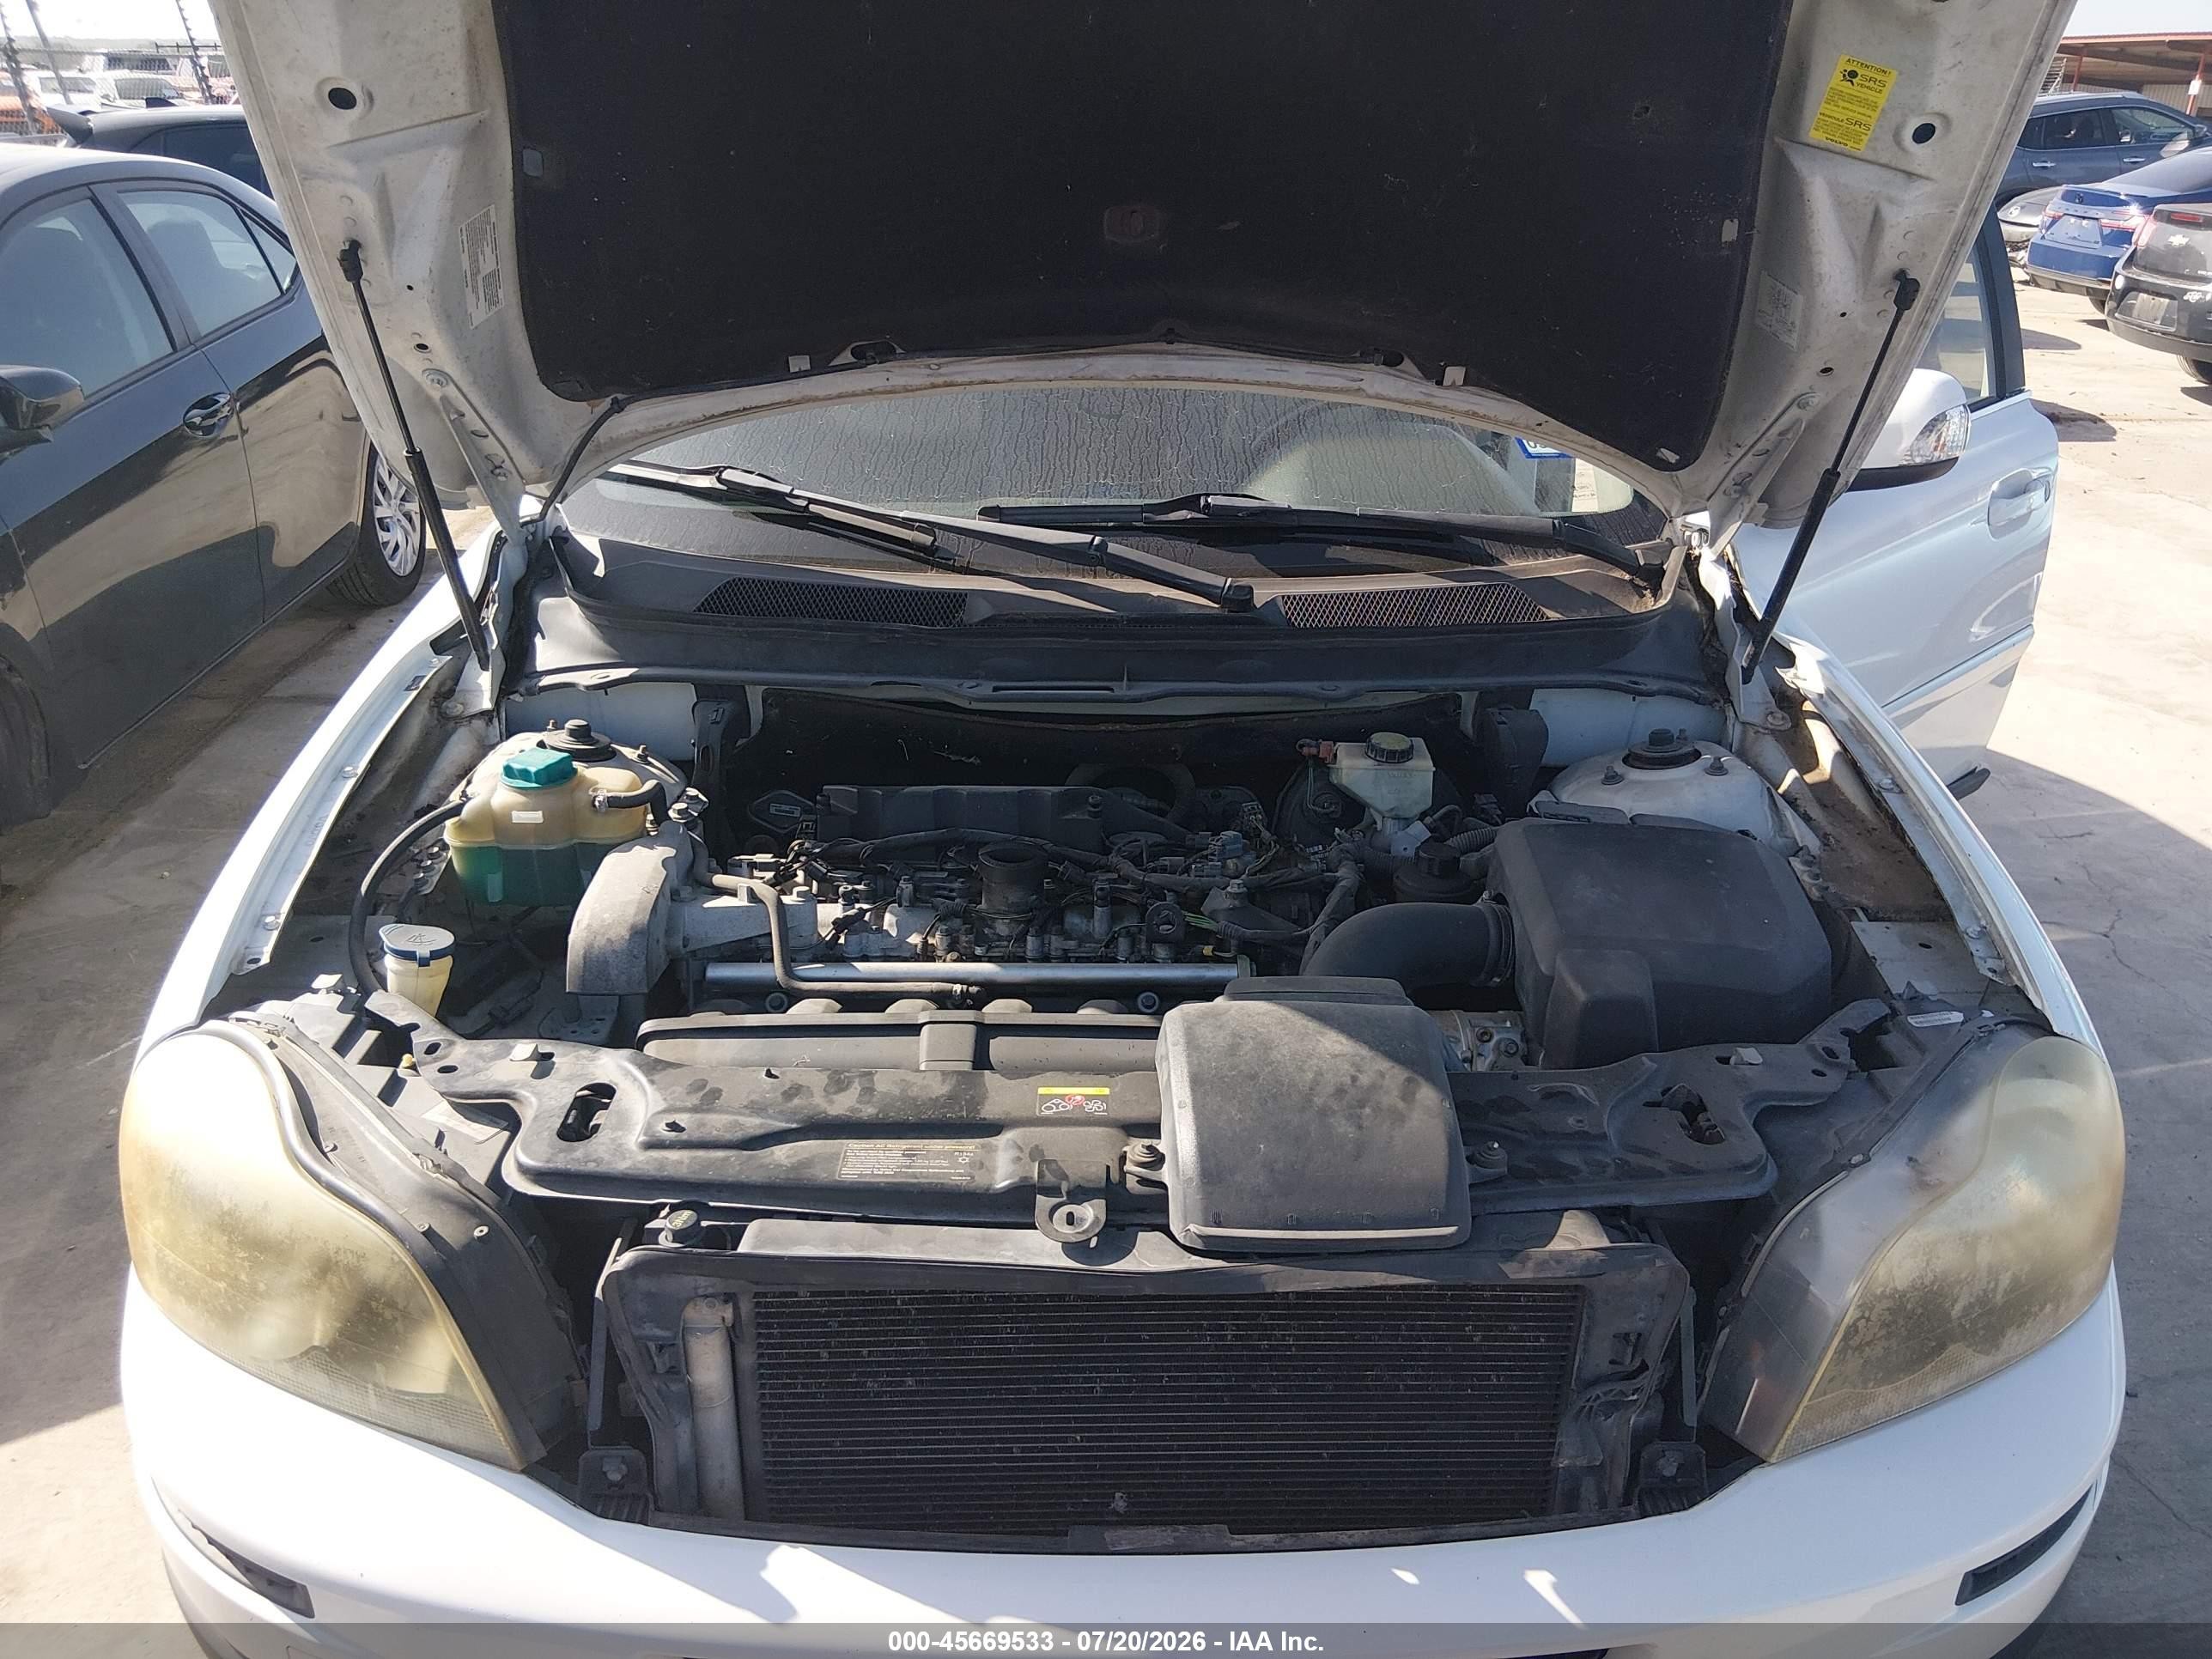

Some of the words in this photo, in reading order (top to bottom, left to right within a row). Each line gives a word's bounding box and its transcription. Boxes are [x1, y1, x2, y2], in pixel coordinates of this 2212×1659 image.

[1859, 74, 1888, 88] SRS
[1856, 83, 1883, 94] VEHICLE
[1845, 116, 1872, 131] SRS
